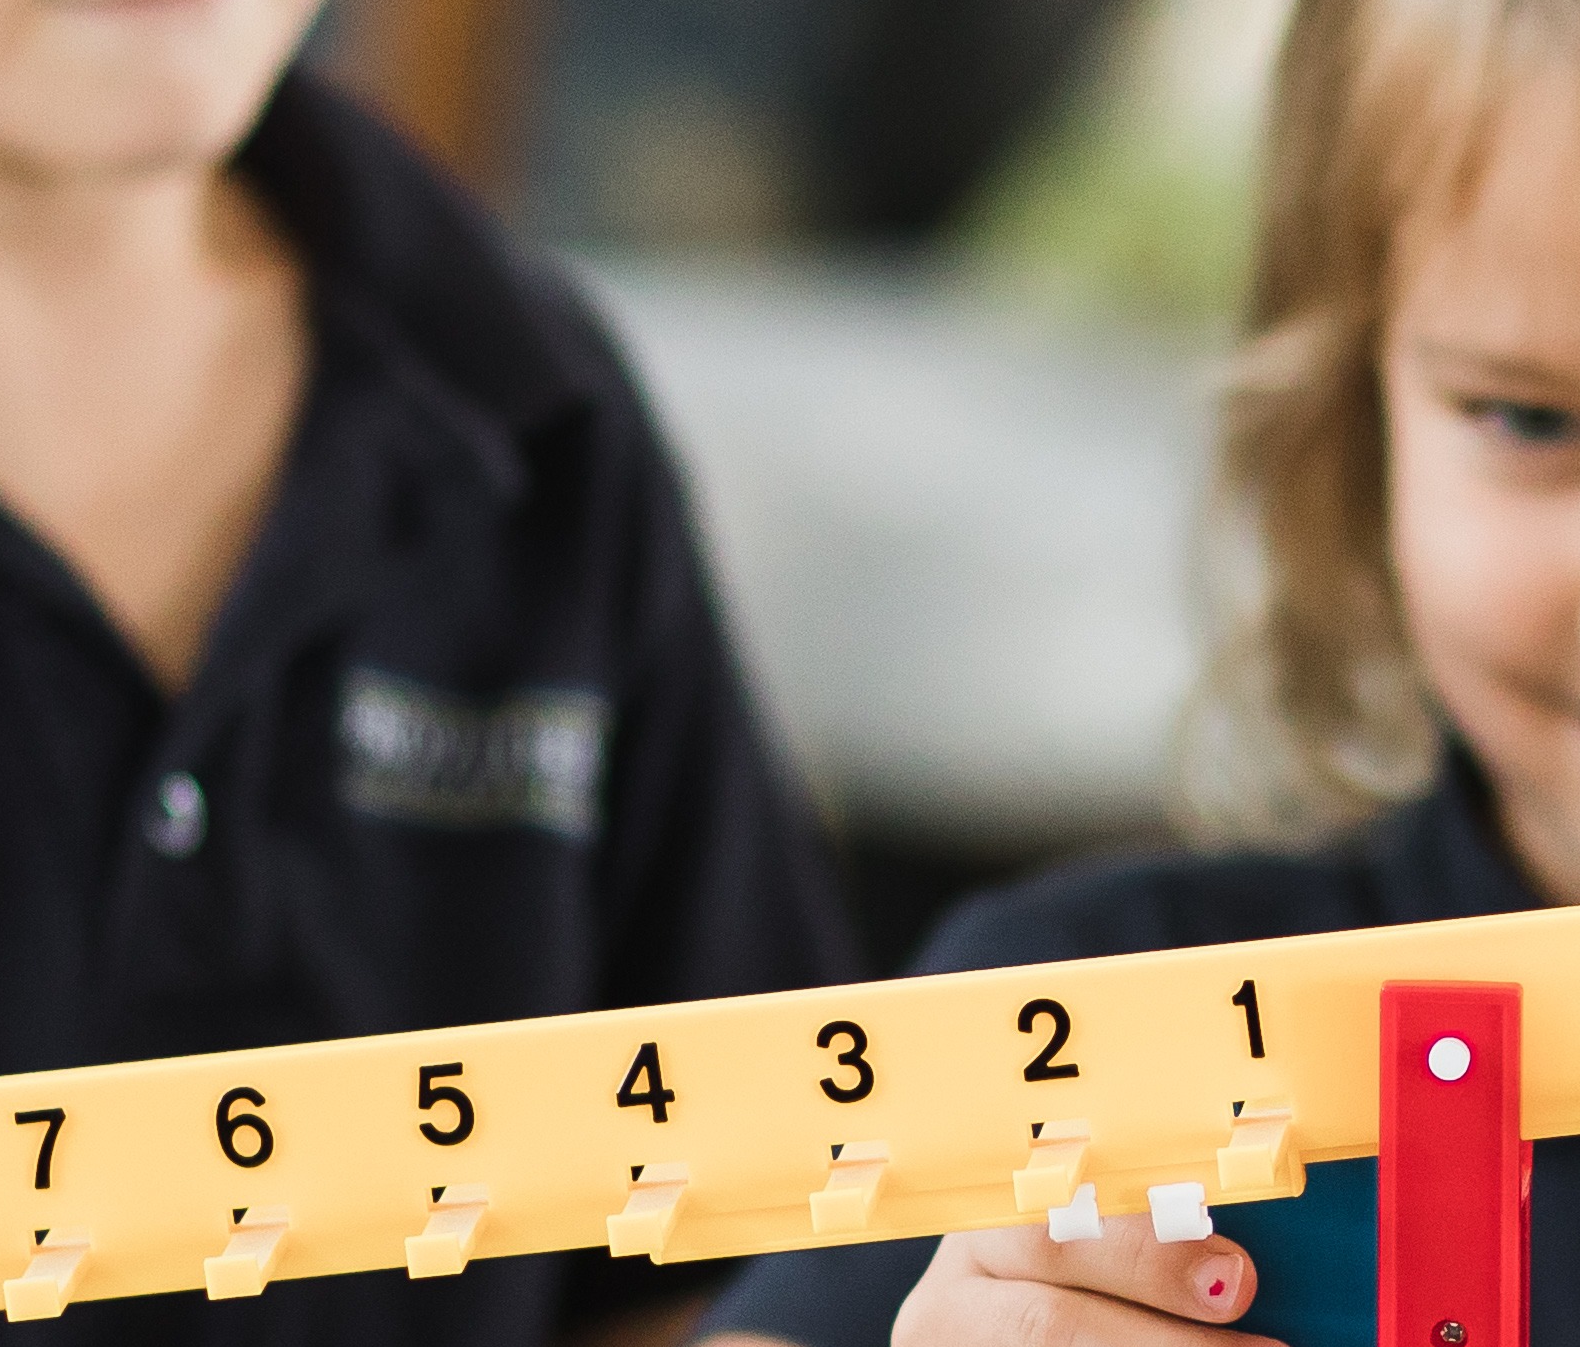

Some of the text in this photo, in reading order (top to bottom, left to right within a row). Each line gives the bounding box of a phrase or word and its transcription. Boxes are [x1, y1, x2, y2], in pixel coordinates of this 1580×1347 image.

[13, 1106, 68, 1191] 7
[214, 1085, 275, 1170] 6
[417, 1060, 476, 1148] 5
[615, 1040, 677, 1125] 4
[815, 1019, 876, 1105] 3
[1016, 997, 1081, 1084] 2
[1230, 978, 1267, 1060] 1
